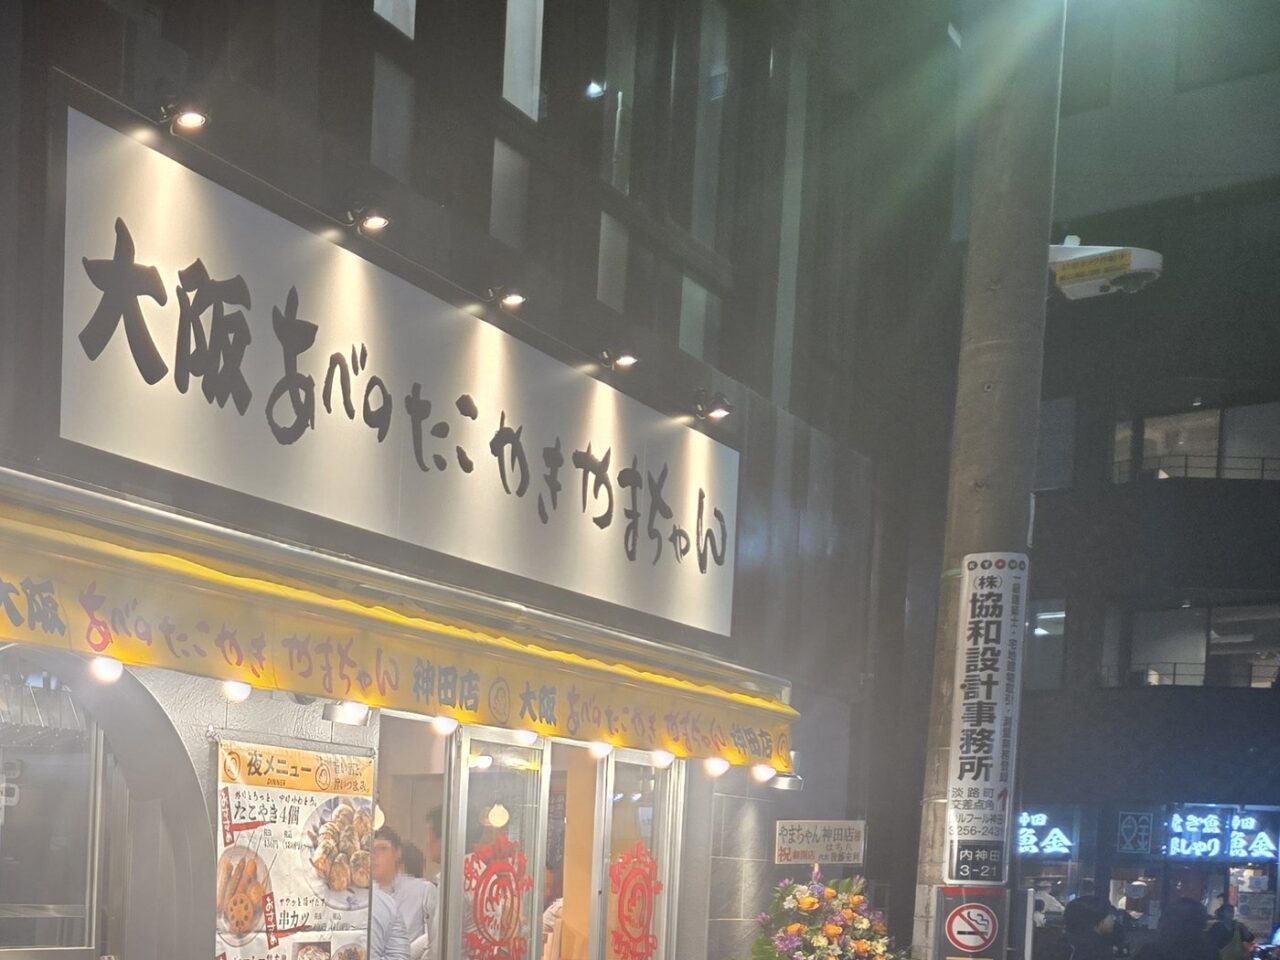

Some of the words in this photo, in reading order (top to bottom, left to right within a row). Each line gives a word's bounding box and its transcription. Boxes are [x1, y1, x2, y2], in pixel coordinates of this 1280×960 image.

[412, 657, 481, 713] 神田店
[520, 681, 558, 727] 大阪
[247, 751, 312, 778] 夜メニュー
[234, 801, 299, 825] たこやき4個
[778, 824, 820, 845] やまちゃん
[960, 849, 1000, 860] 内神田
[960, 865, 997, 876] 3-21
[279, 909, 310, 929] 串カツ
